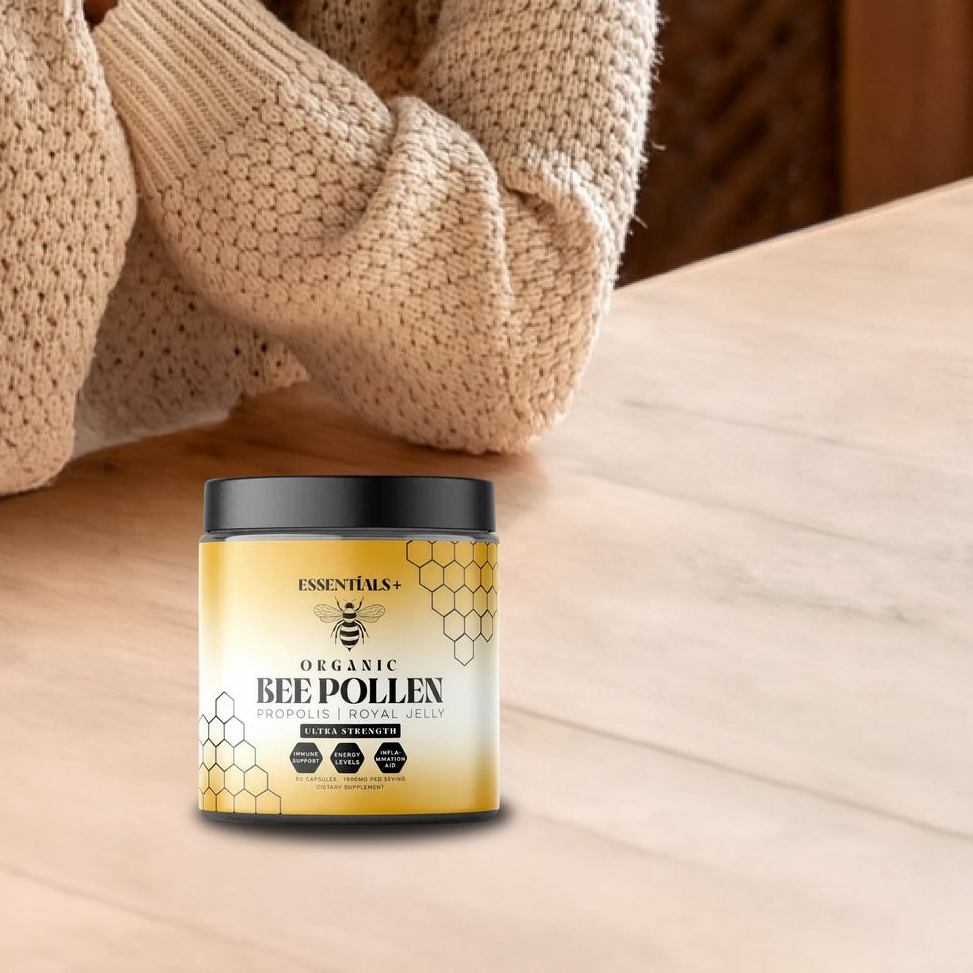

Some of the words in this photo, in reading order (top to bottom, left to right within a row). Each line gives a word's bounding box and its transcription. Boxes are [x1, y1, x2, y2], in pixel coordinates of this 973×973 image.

[300, 659, 397, 672] ORGANIC
[256, 677, 311, 704] BEE
[318, 677, 444, 704] POLLEN
[257, 708, 330, 719] PROPOLIS
[349, 708, 398, 719] ROYAL
[406, 708, 445, 719] JELLY
[304, 727, 338, 735] ULTRA
[341, 727, 397, 735] STRENGTH
